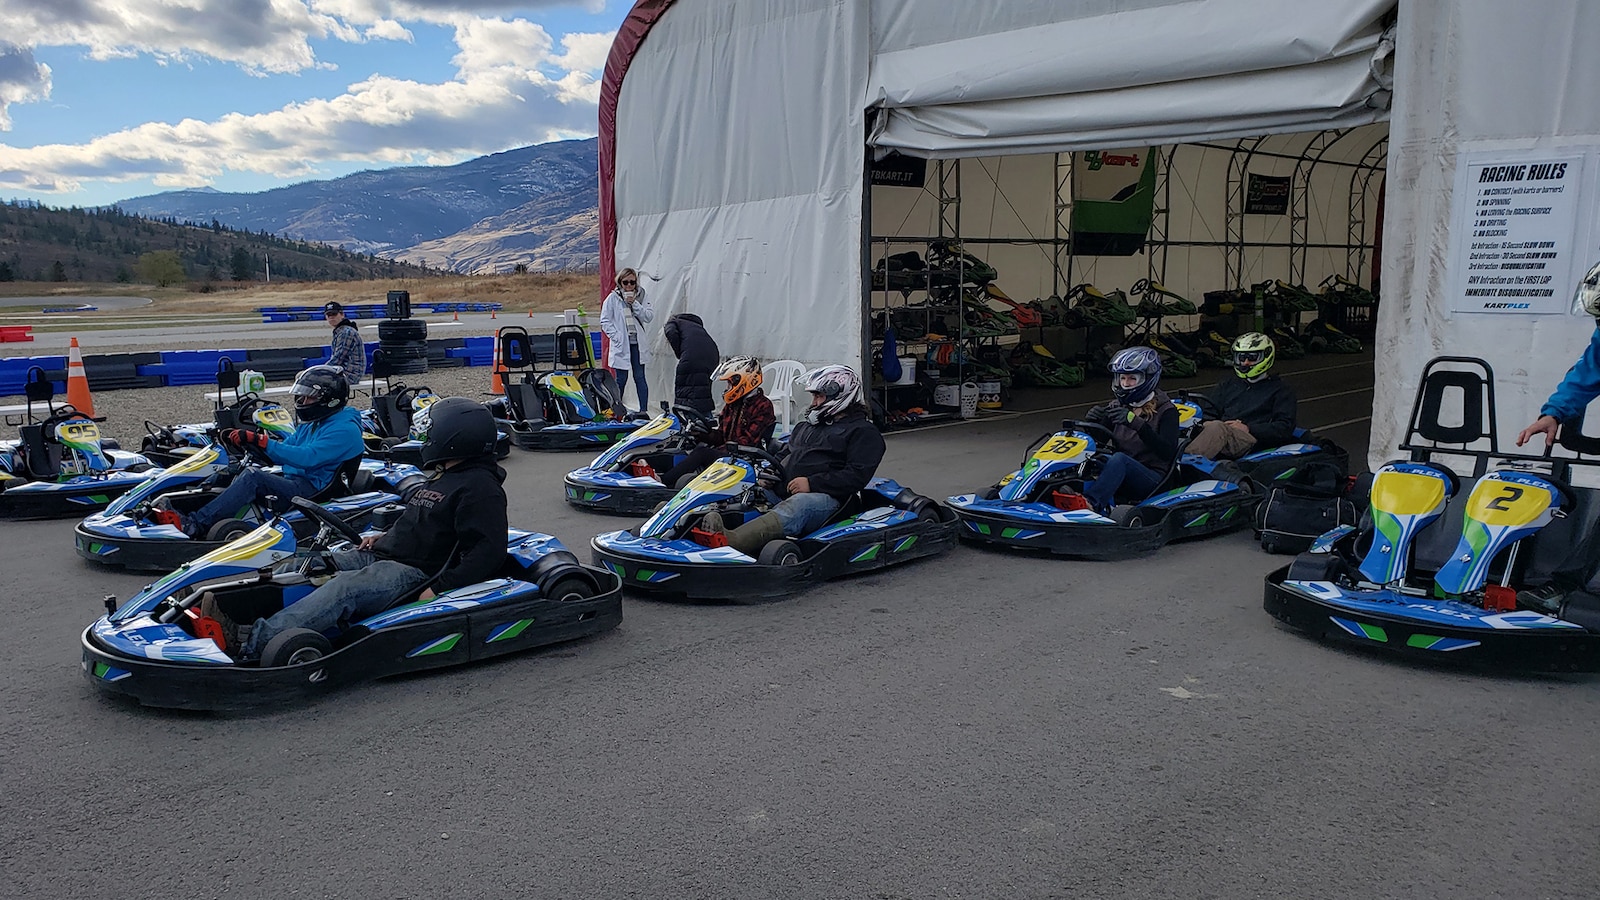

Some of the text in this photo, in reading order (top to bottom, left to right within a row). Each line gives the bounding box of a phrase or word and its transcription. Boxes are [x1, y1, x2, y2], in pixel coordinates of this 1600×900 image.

[1478, 163, 1568, 183] RACING RULES
[1483, 188, 1491, 196] NO
[1491, 187, 1511, 195] CONTACT
[1511, 187, 1523, 195] (with
[1523, 186, 1535, 194] karts
[1541, 184, 1564, 194] barriers)
[1489, 198, 1511, 206] SPINNING
[1487, 208, 1505, 216] LEAVING
[1513, 207, 1531, 216] RACING
[1530, 206, 1552, 215] SURFACE
[1479, 219, 1486, 227] NO
[1486, 219, 1507, 227] DRIFTING
[1485, 229, 1508, 237] BLOCKING
[1507, 241, 1524, 249] Second
[1523, 241, 1538, 249] SLOW
[1538, 241, 1555, 249] DOWN
[1478, 252, 1500, 260] Infraction
[1500, 262, 1546, 270] DISQUALIFICATION
[1468, 275, 1552, 285] ANY Infraction on the FIRST LAP
[1465, 288, 1555, 297] IMMEDIATE DISQUALIFICATION
[563, 377, 571, 387] 1
[264, 410, 288, 423] 96
[68, 424, 97, 440] 95
[1040, 439, 1078, 454] 38
[1485, 486, 1524, 512] 2
